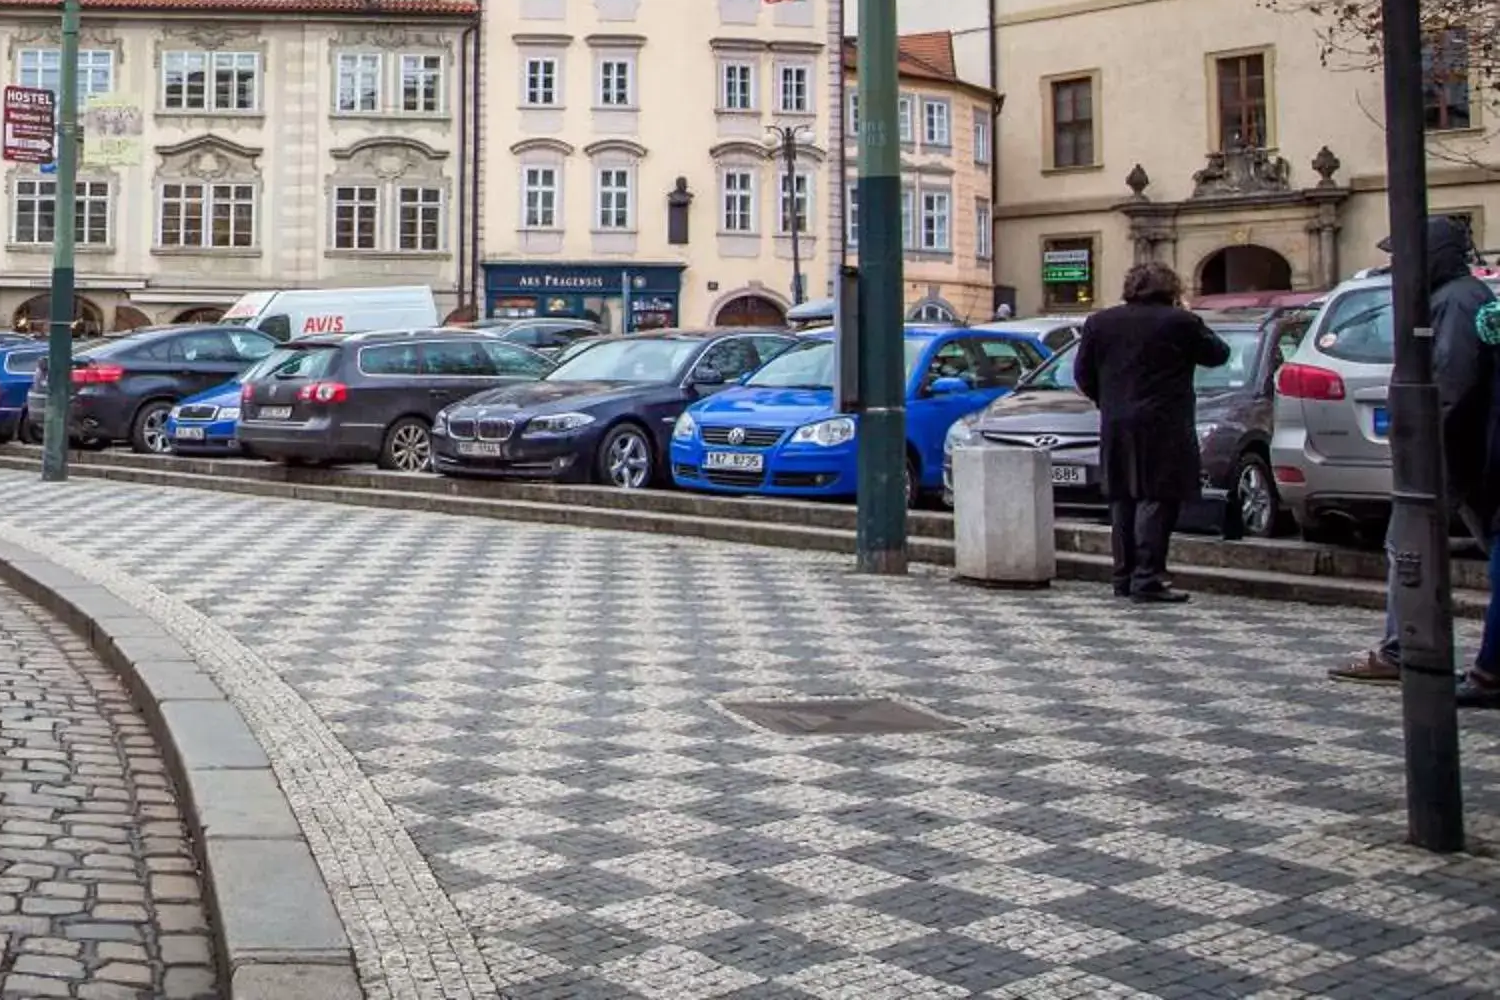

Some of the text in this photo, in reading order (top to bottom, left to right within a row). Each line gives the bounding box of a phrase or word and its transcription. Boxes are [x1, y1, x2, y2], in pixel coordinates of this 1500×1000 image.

[7, 90, 53, 105] HOSTEL
[519, 276, 540, 286] ARS
[304, 315, 344, 333] AVIS
